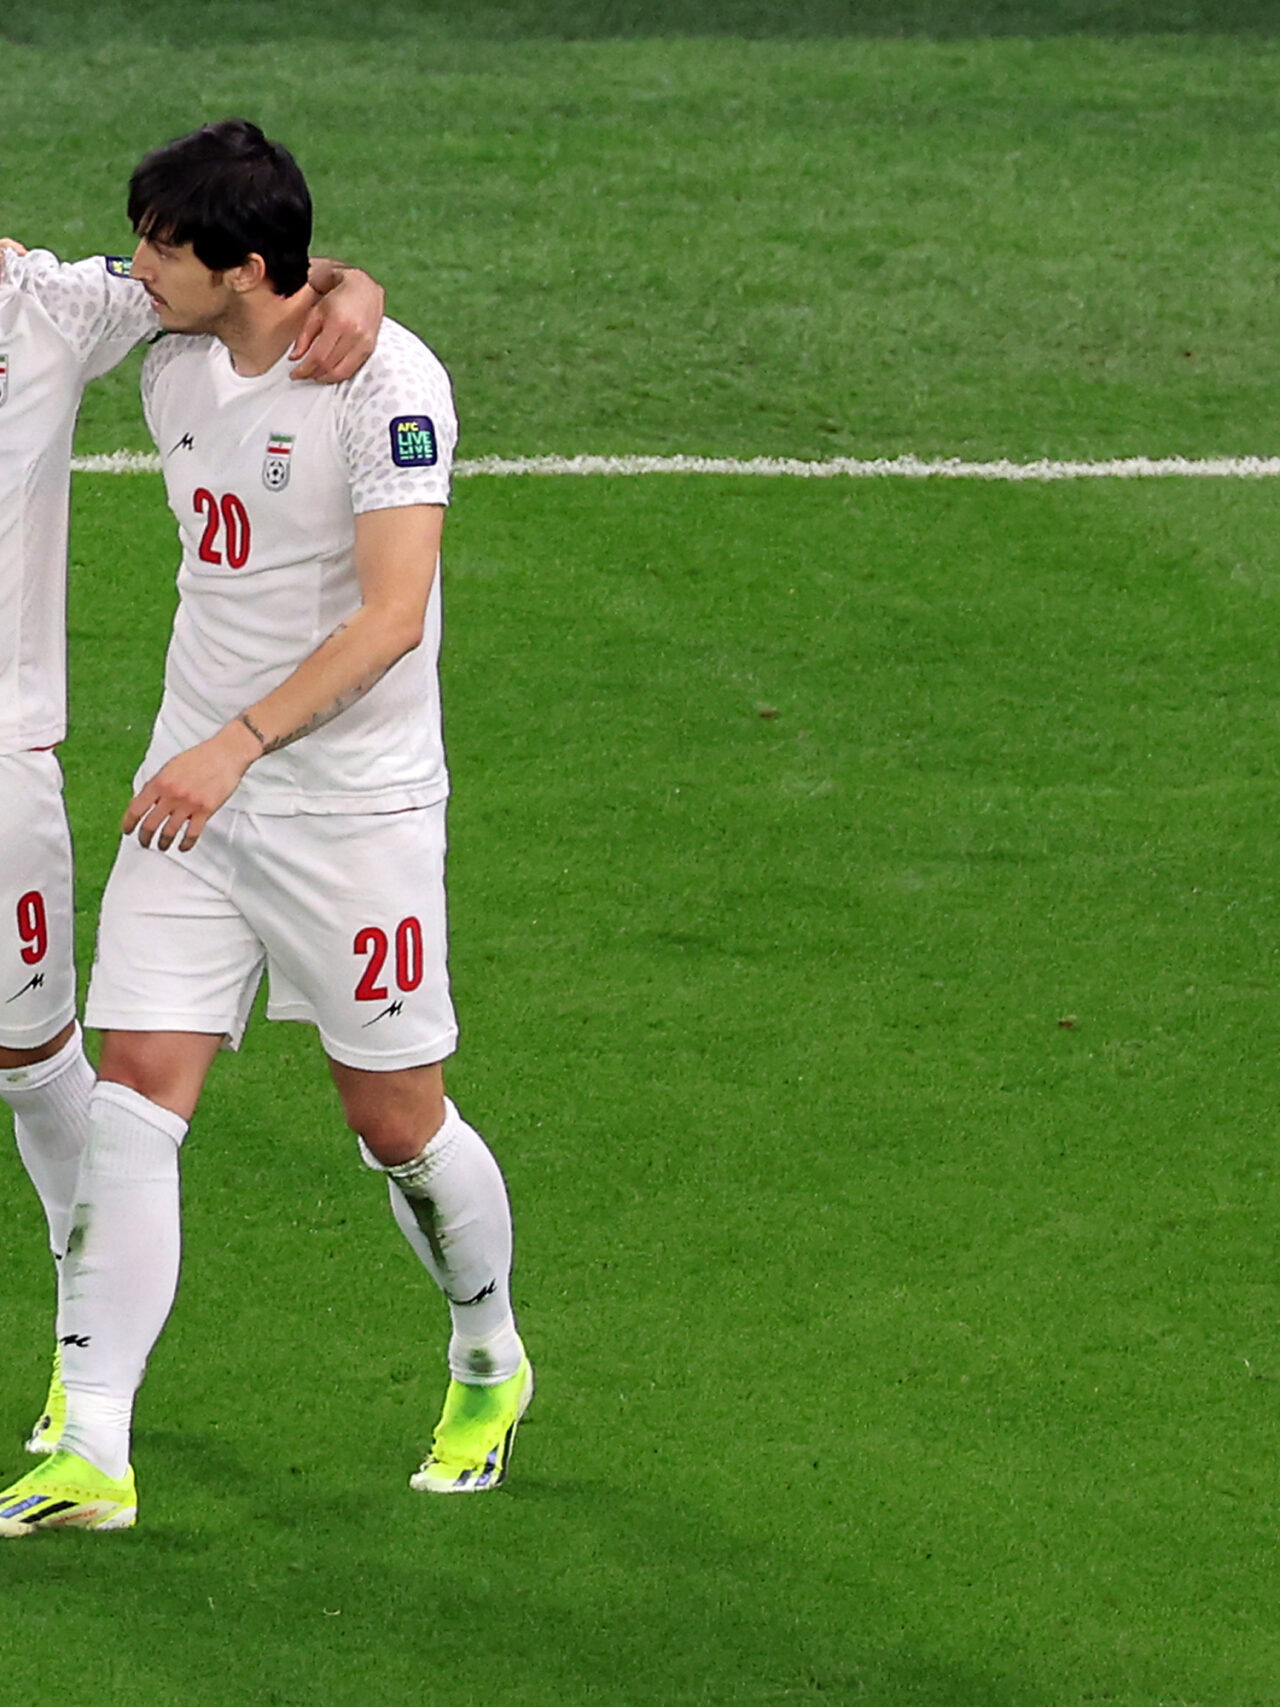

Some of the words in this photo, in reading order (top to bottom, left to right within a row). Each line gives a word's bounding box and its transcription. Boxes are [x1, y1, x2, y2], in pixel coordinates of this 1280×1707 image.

[397, 421, 419, 432] AFC
[398, 430, 431, 446] LIVE
[193, 487, 251, 569] 20
[17, 890, 48, 964] 9
[353, 915, 423, 1001] 20
